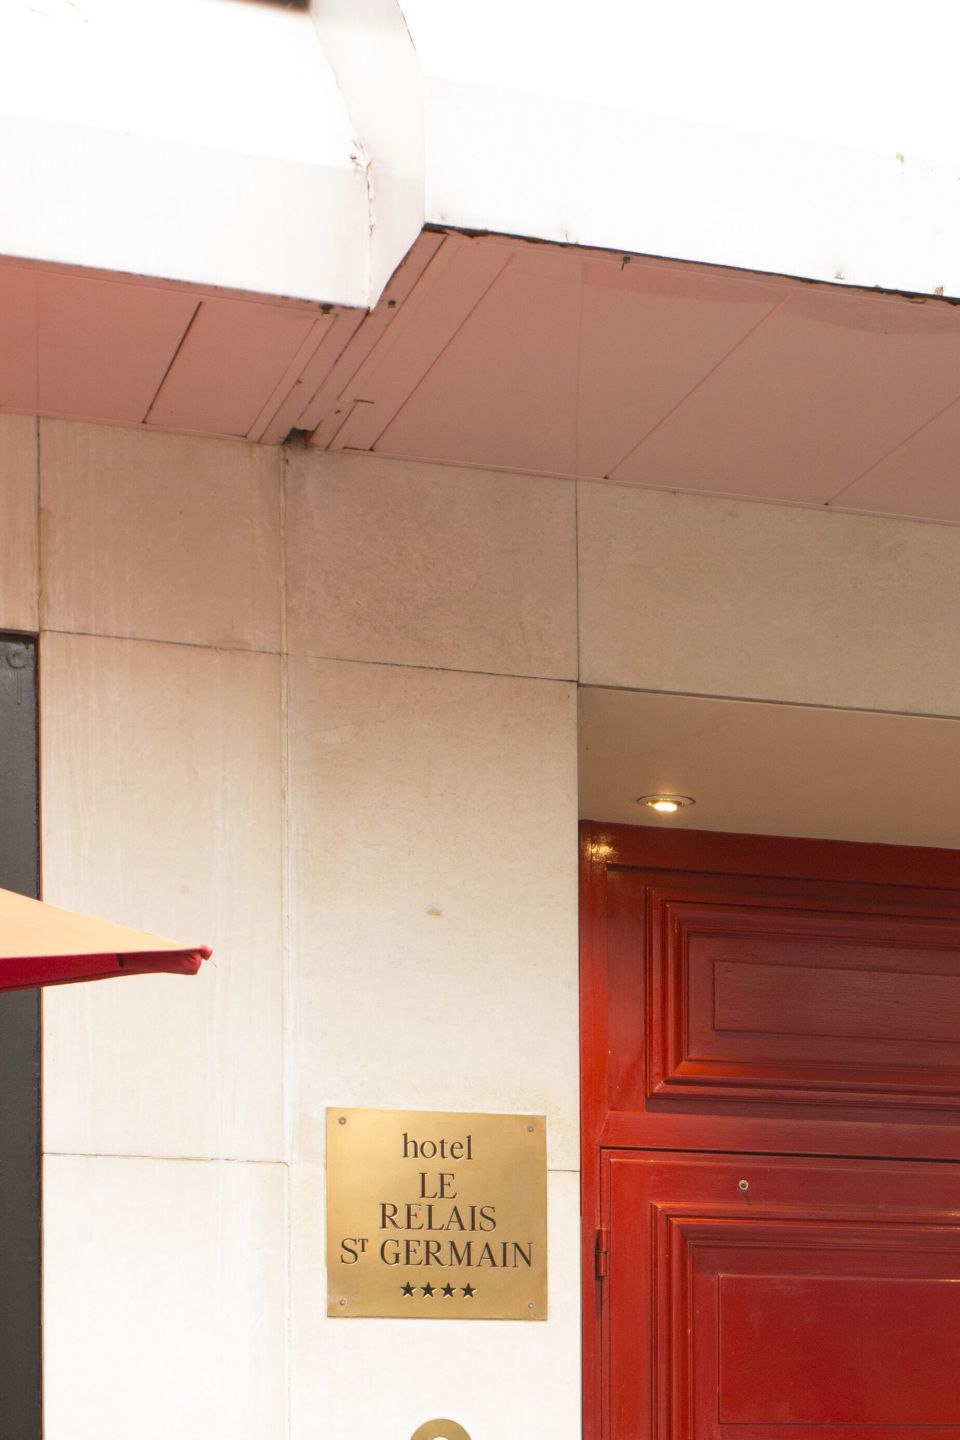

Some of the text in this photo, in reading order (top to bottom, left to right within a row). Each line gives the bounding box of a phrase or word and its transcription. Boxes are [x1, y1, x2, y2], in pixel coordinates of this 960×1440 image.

[402, 1133, 473, 1161] hotel
[418, 1172, 457, 1200] LE
[379, 1203, 497, 1233] RELAIS
[380, 1239, 533, 1269] GERMAIN
